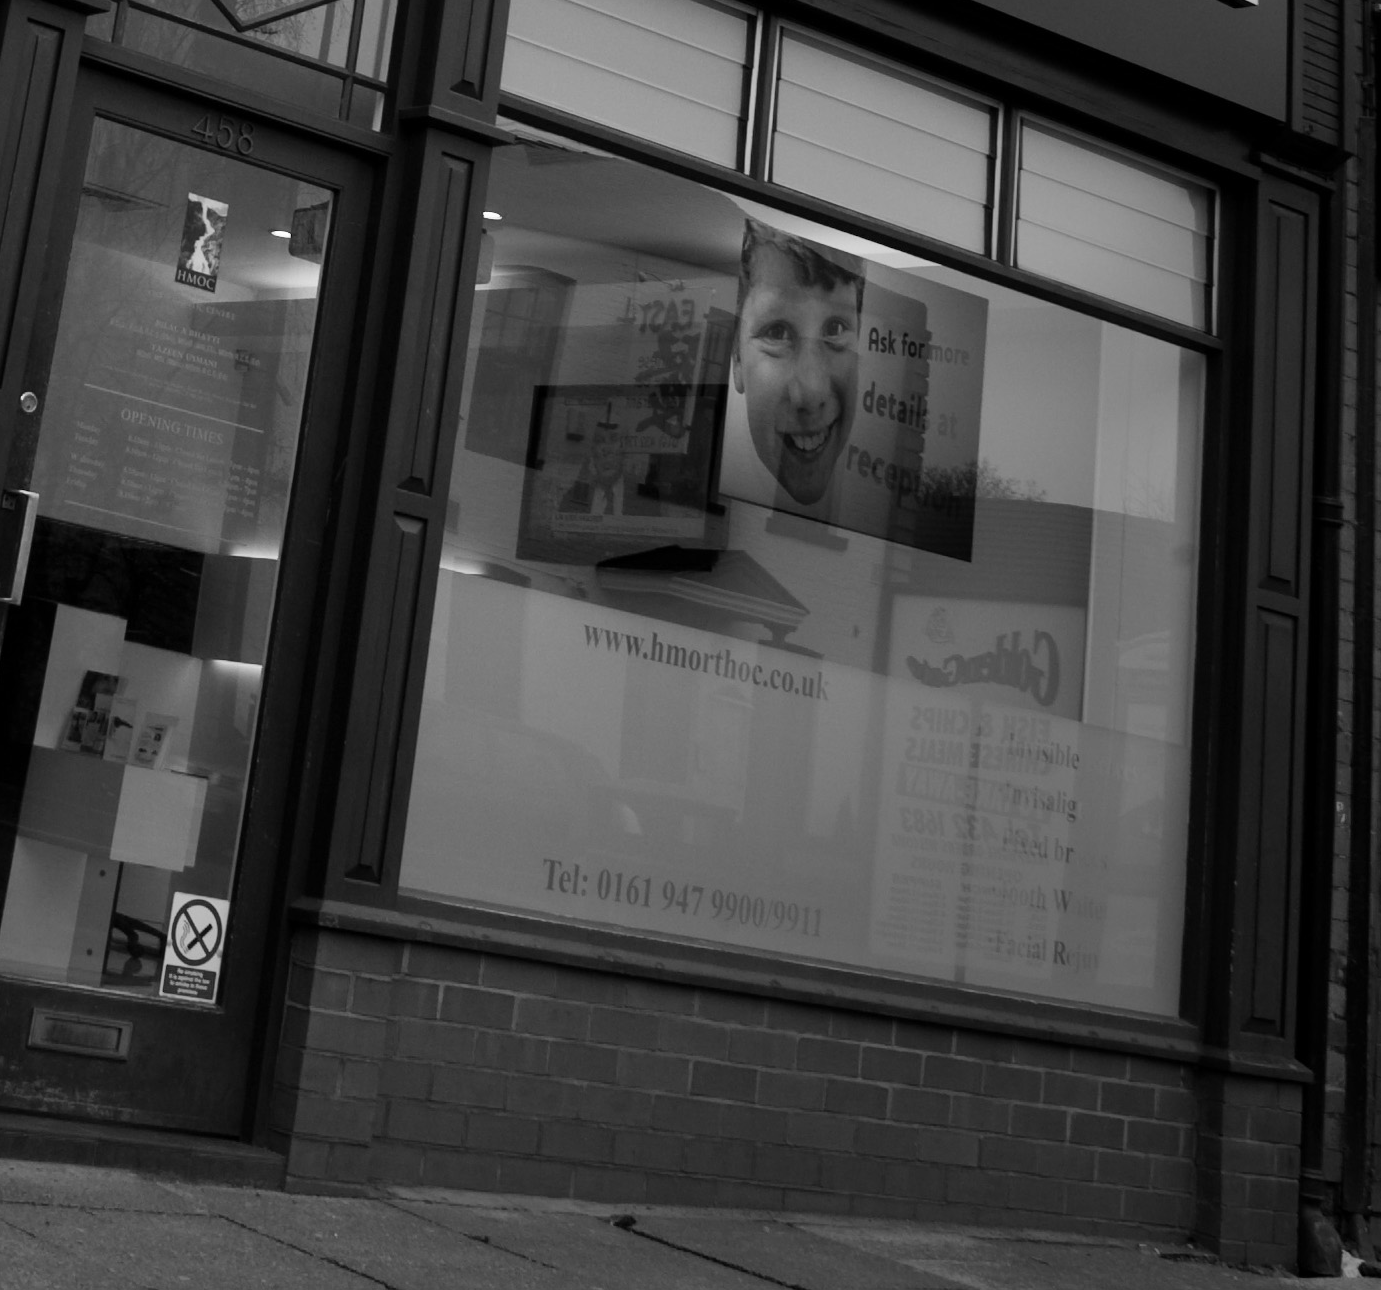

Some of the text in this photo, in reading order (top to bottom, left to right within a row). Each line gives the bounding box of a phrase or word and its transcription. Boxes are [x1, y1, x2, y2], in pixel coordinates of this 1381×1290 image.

[190, 114, 255, 155] 458
[177, 269, 217, 291] HMOC
[867, 326, 971, 367] Ask for more
[120, 407, 225, 446] OPENING TIMES
[862, 380, 958, 440] details at
[584, 624, 829, 701] www.hmorthoc.co.uk
[542, 857, 822, 938] Tel: 0161 947 9900/9911
